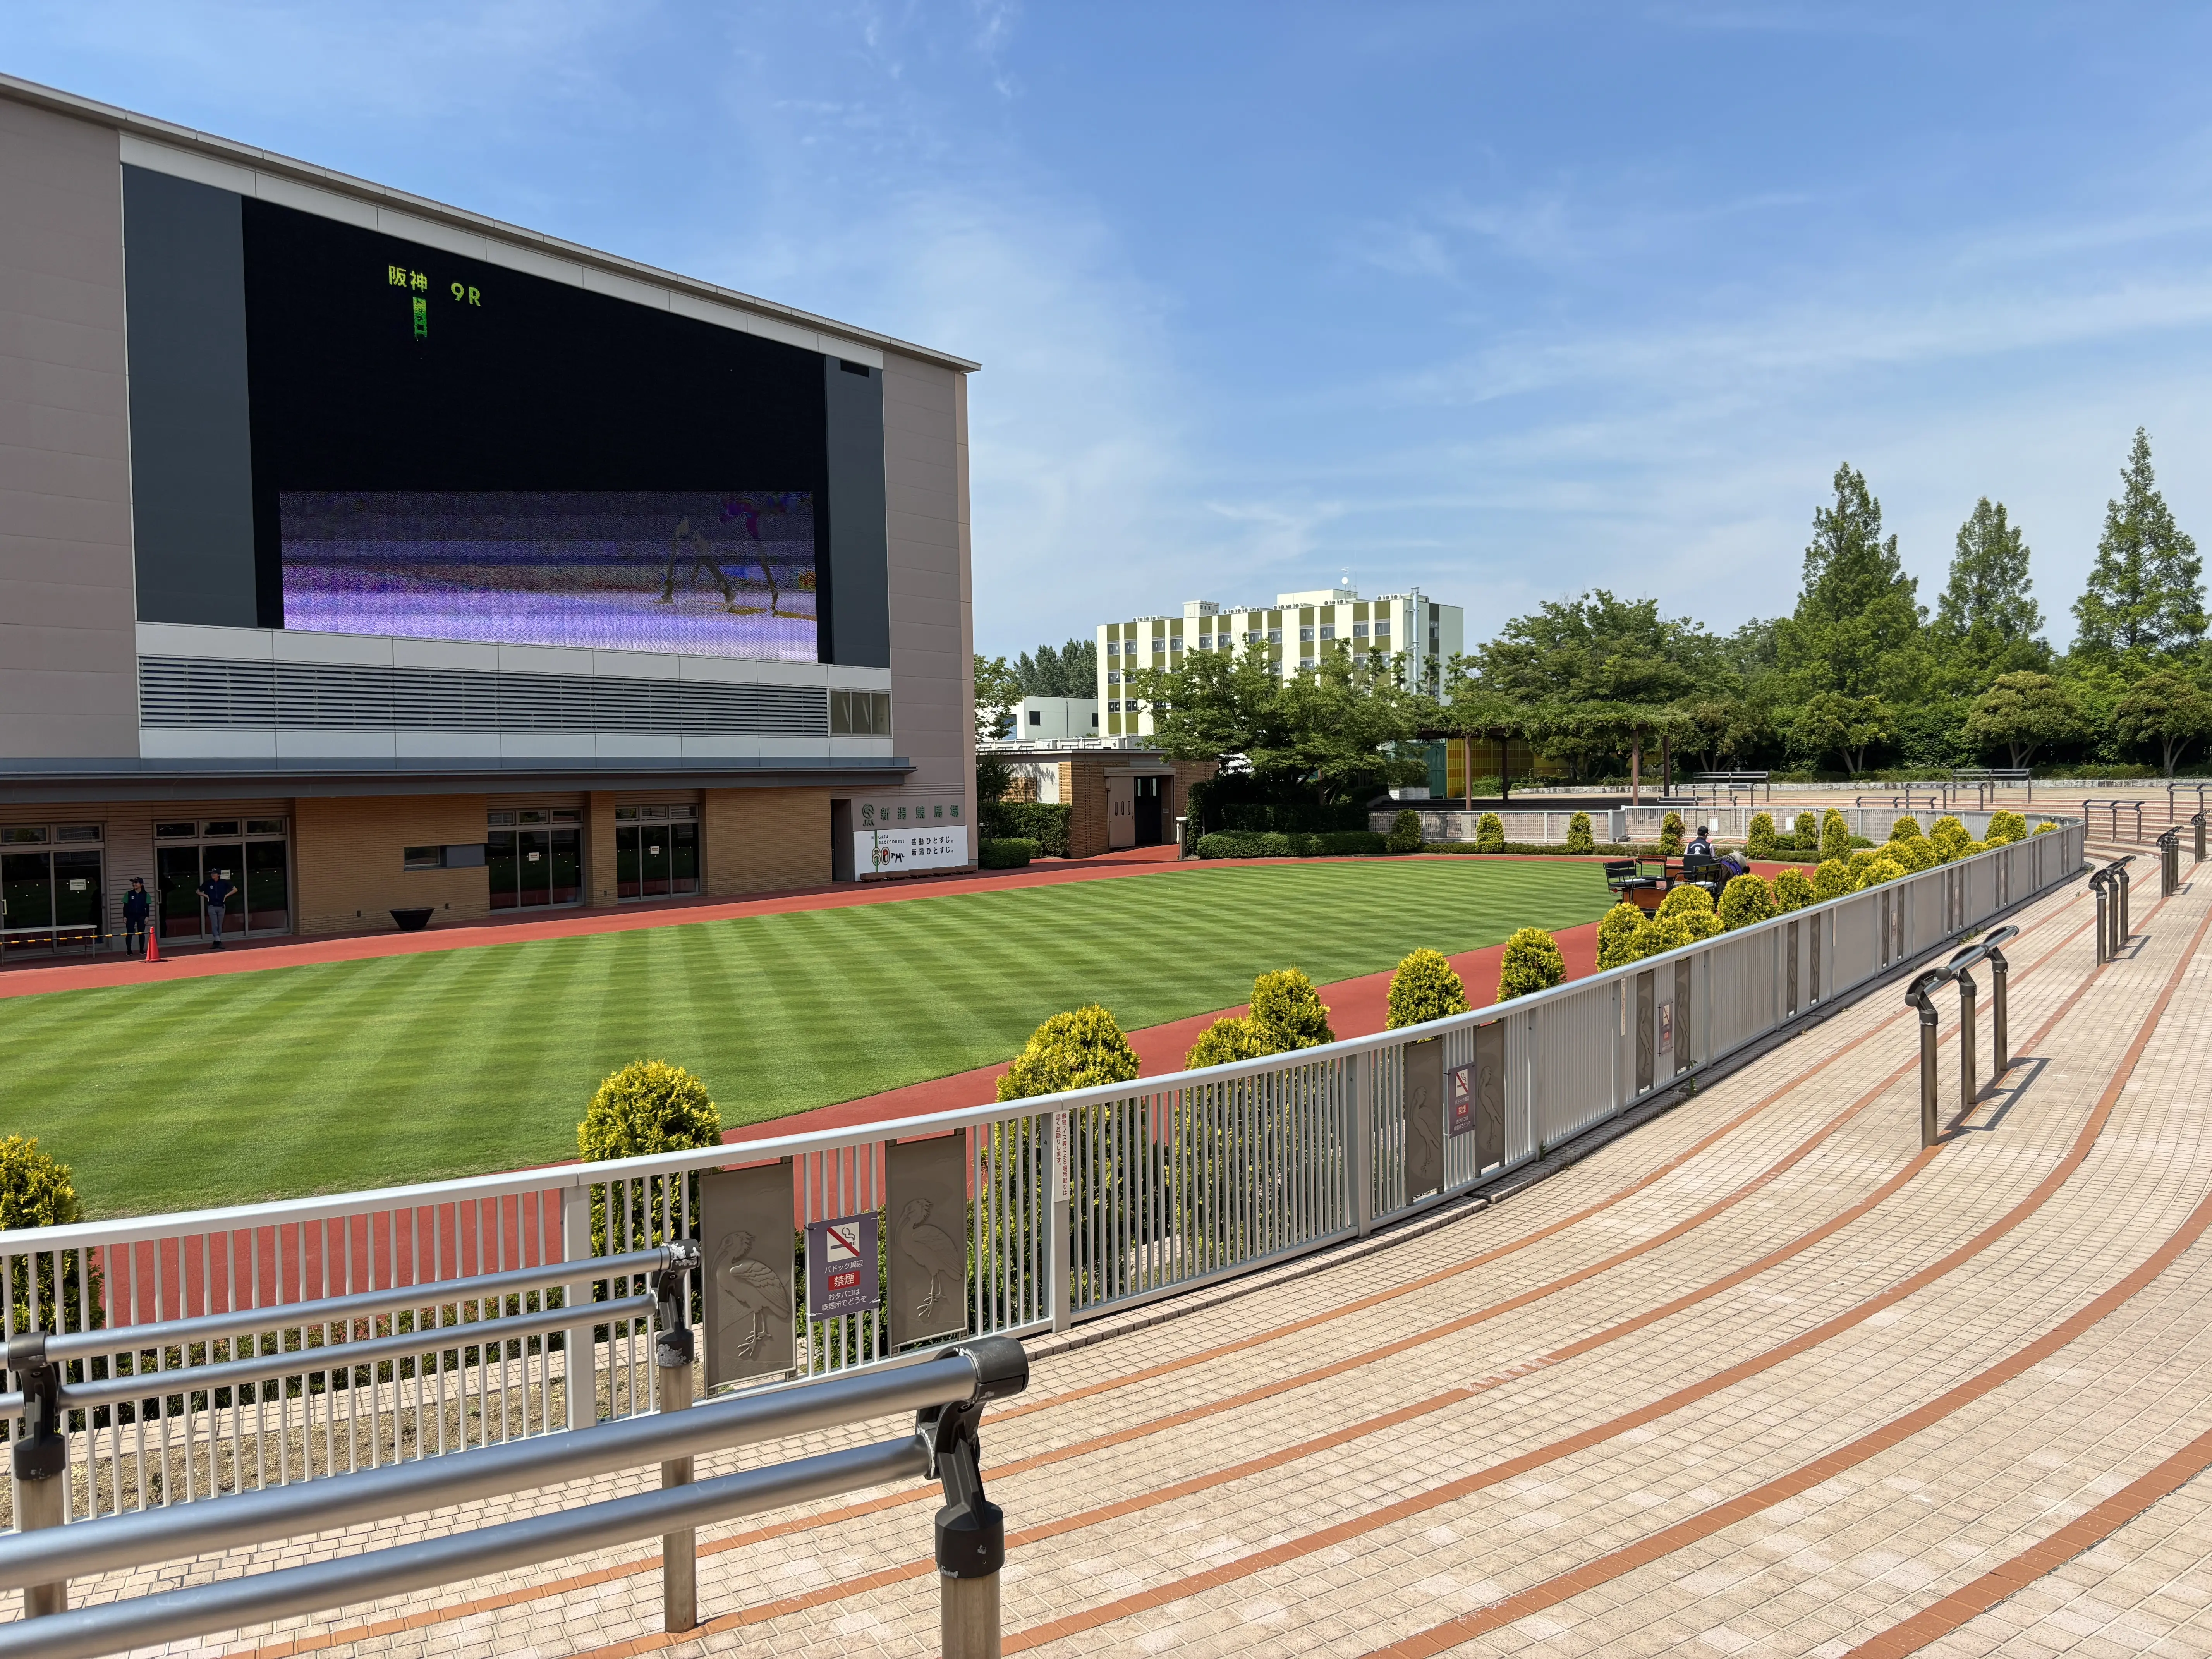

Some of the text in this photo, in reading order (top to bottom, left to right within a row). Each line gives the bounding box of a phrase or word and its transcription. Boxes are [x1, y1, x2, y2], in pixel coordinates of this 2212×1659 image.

[389, 265, 481, 306] 阪神 9R
[880, 805, 959, 821] 新潟競馬場
[912, 847, 953, 856] 新潟ひとすじ。
[834, 1273, 854, 1287] 禁煙
[829, 1288, 860, 1301] おタバコは
[822, 1295, 867, 1311] 喫煙所でどうぞ
